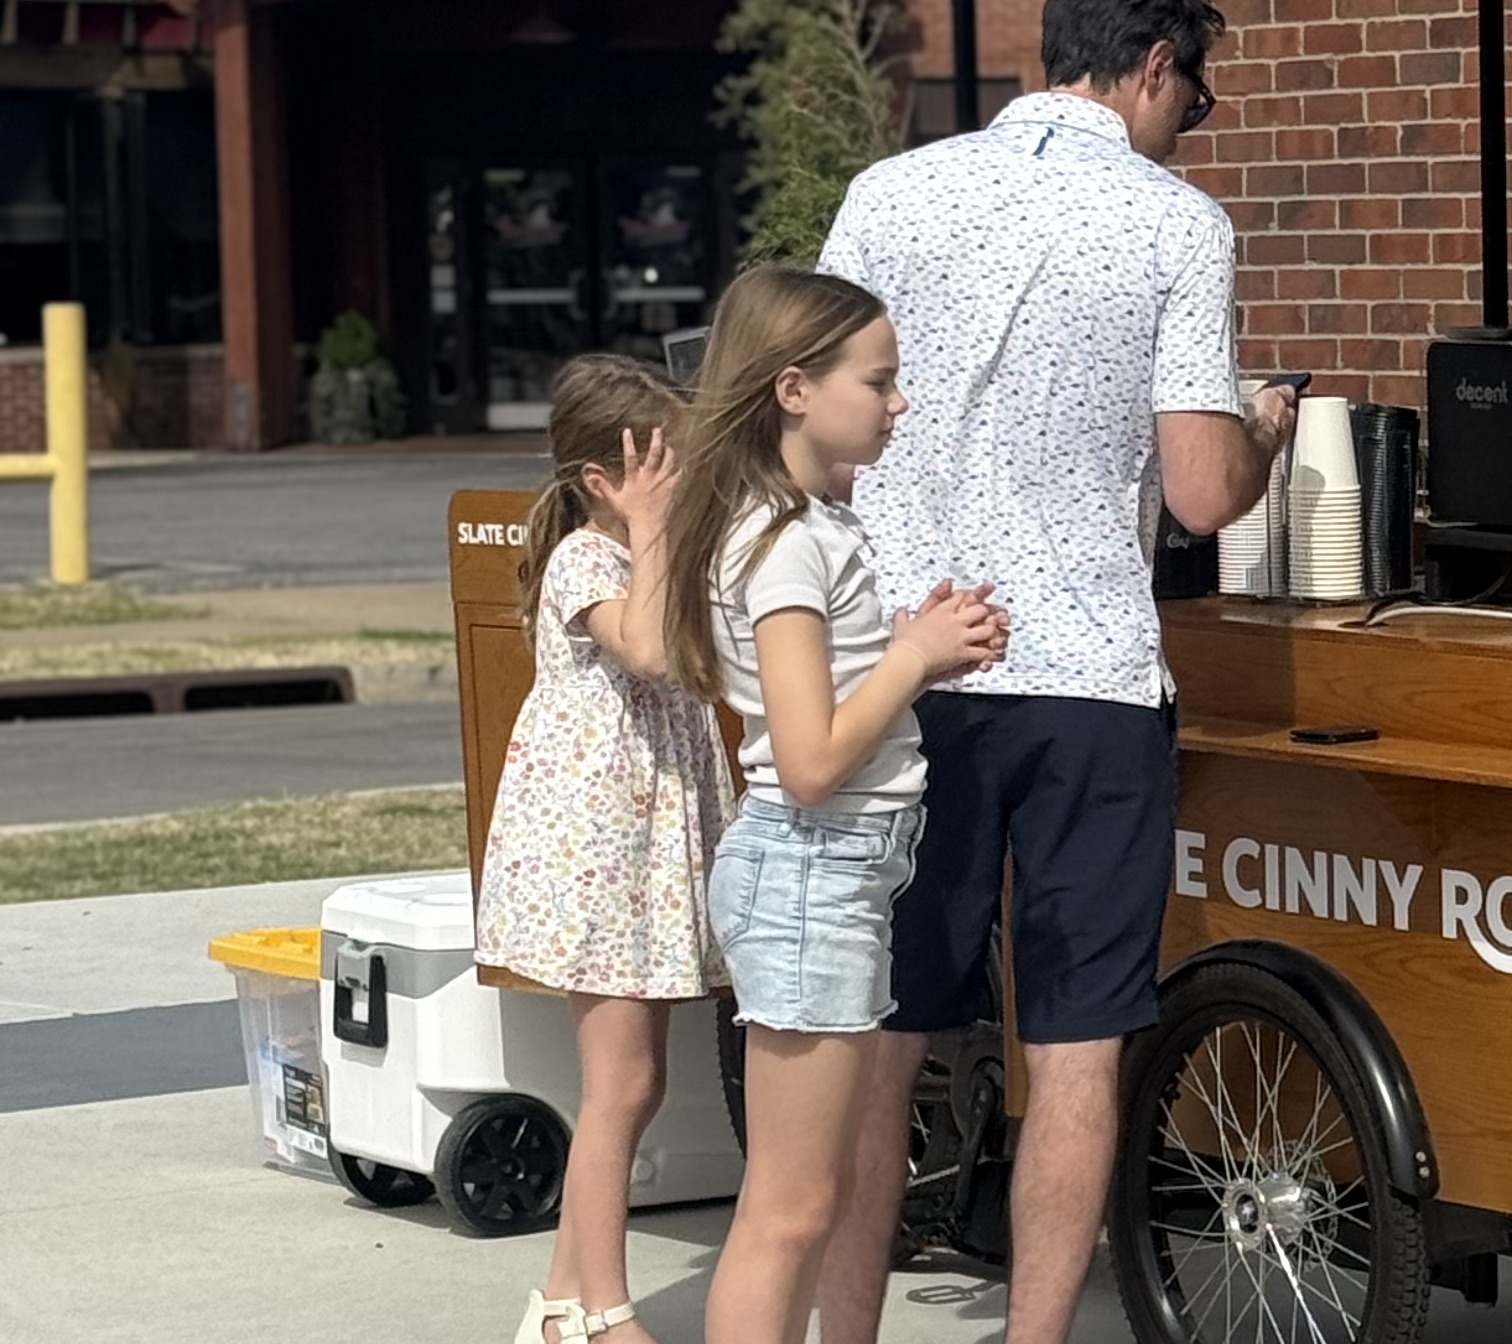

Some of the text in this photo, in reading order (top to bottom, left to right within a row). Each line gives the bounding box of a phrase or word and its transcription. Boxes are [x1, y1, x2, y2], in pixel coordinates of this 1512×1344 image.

[1455, 376, 1509, 405] decent
[457, 521, 506, 546] SLATE
[1222, 836, 1424, 932] CINNY
